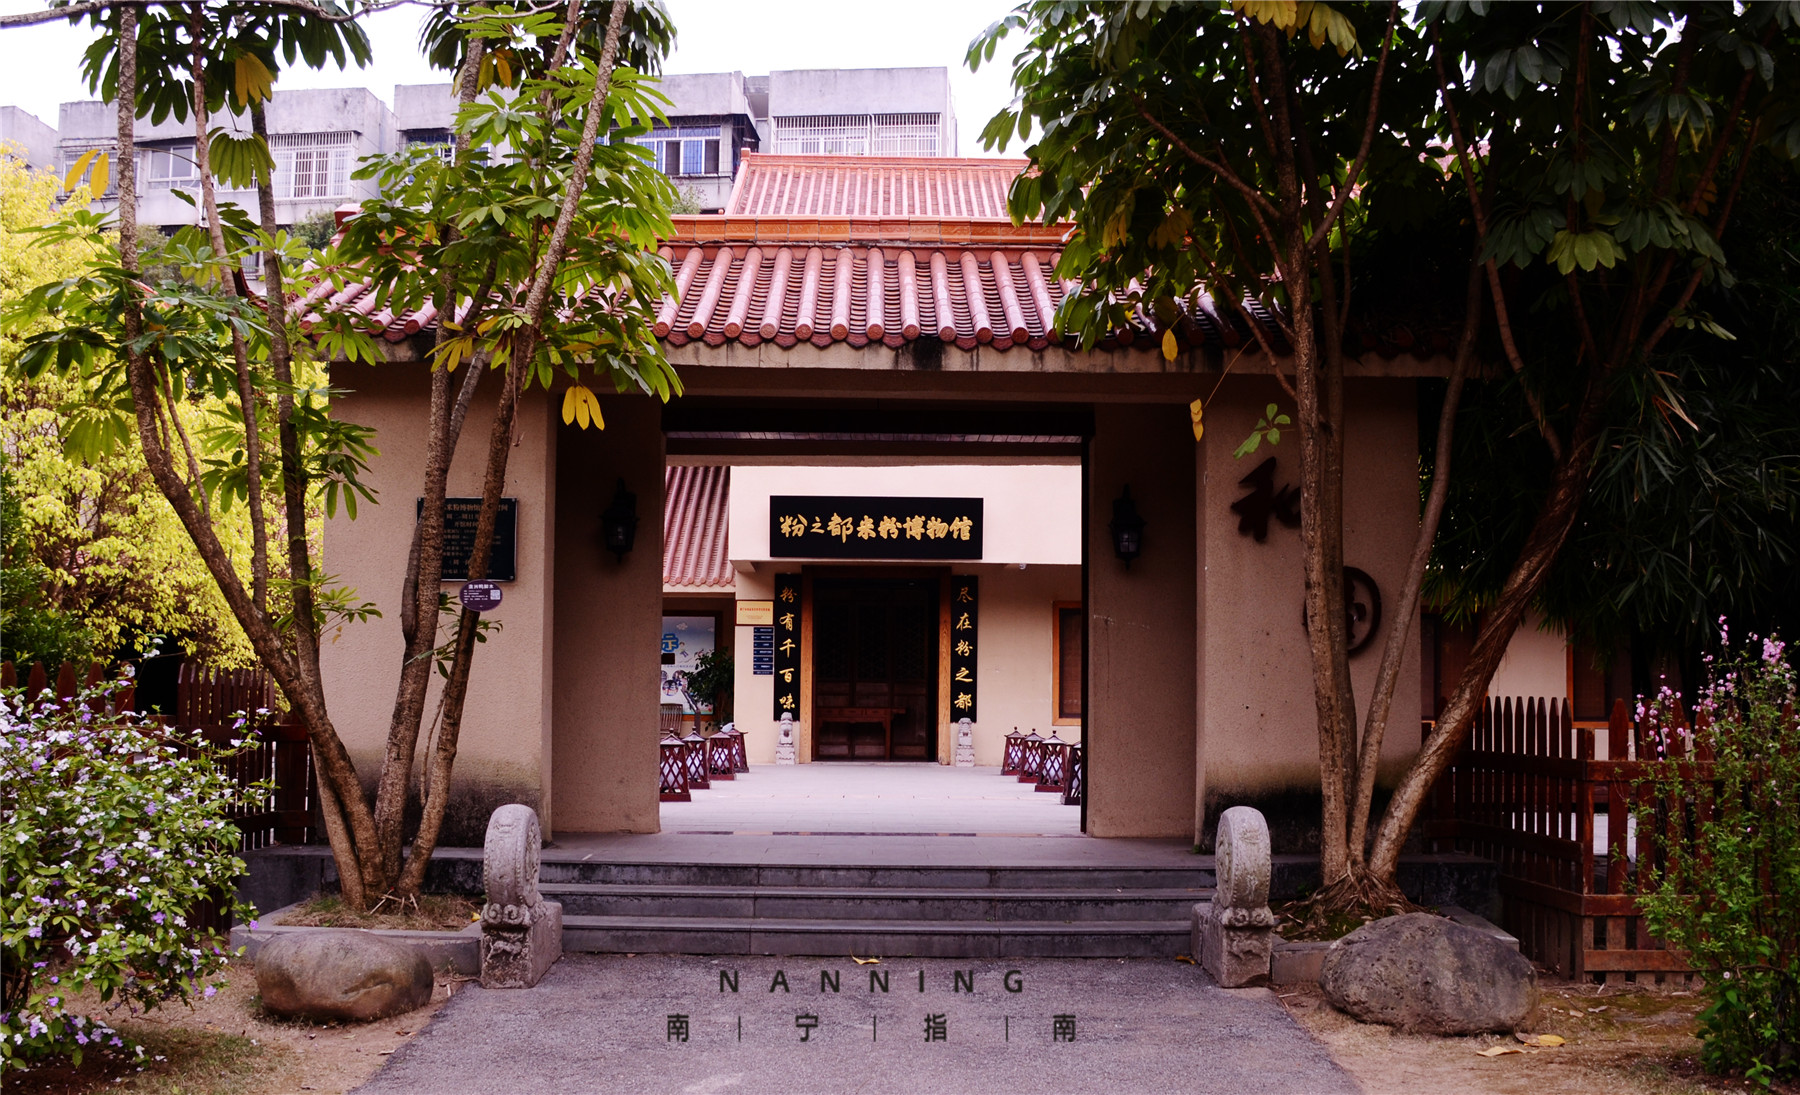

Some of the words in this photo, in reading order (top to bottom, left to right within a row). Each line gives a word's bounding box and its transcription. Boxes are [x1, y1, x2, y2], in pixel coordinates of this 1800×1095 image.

[779, 512, 973, 543] 粉之都米粉博物馆
[779, 586, 797, 710] 粉有千百味
[954, 586, 973, 712] 尽在粉之都
